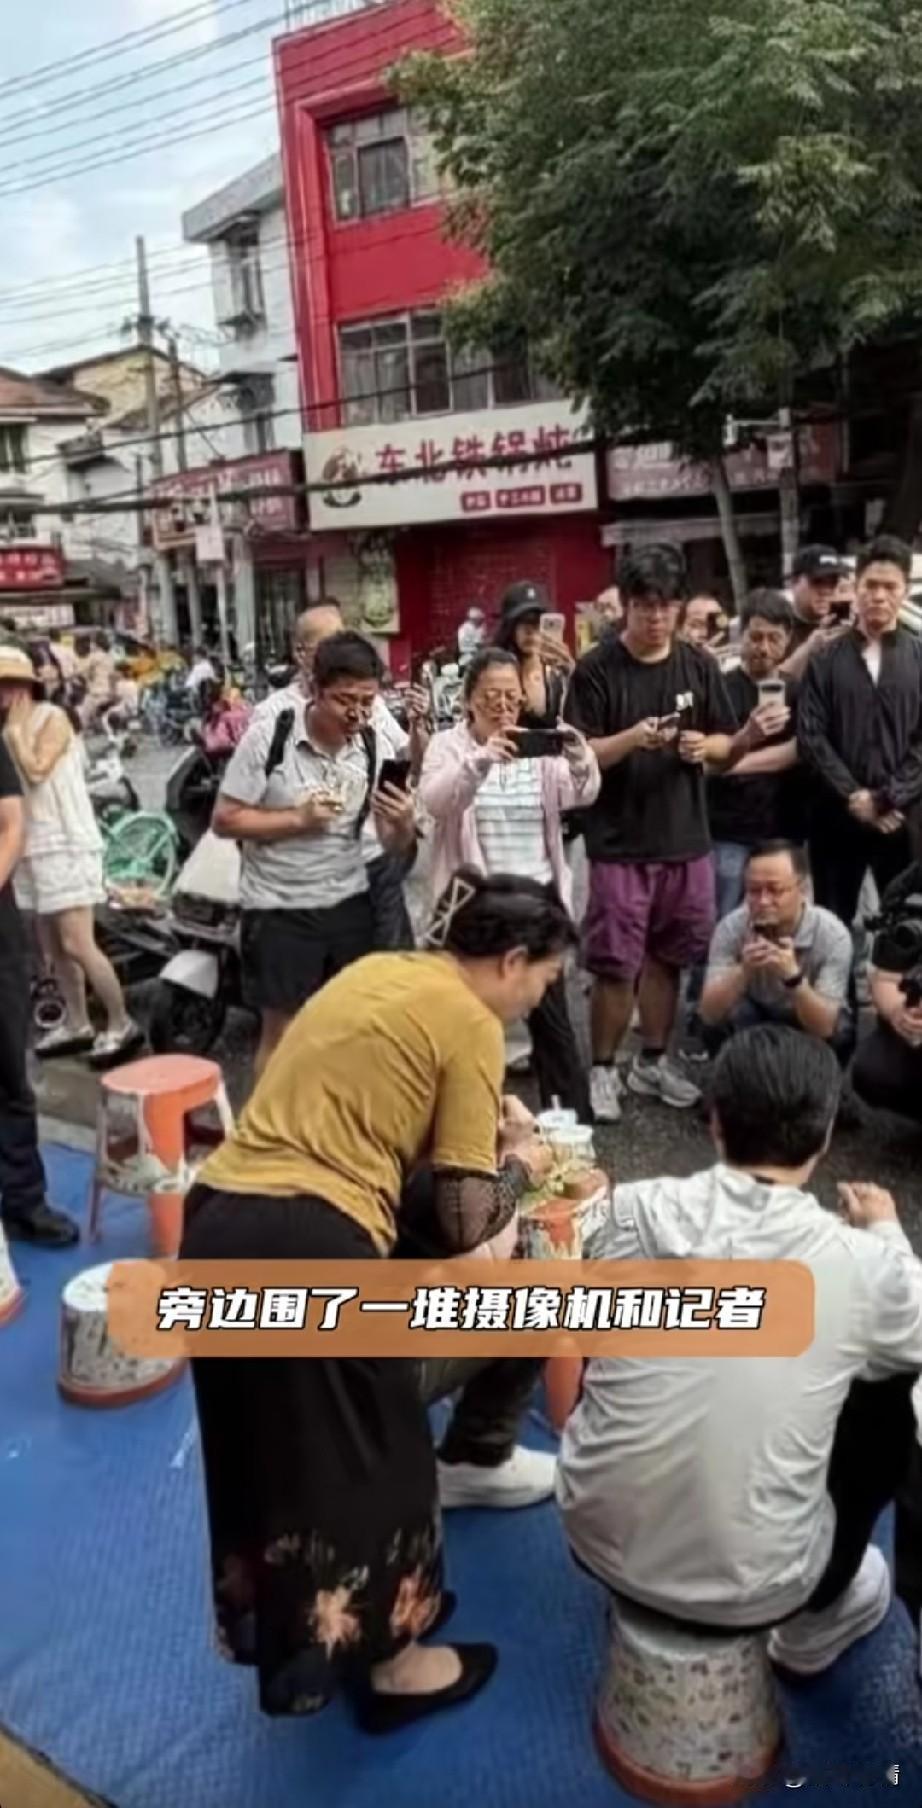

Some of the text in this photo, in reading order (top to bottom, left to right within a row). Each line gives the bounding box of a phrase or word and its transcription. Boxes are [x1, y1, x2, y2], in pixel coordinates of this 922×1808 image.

[376, 424, 572, 484] 东北铁锅炖
